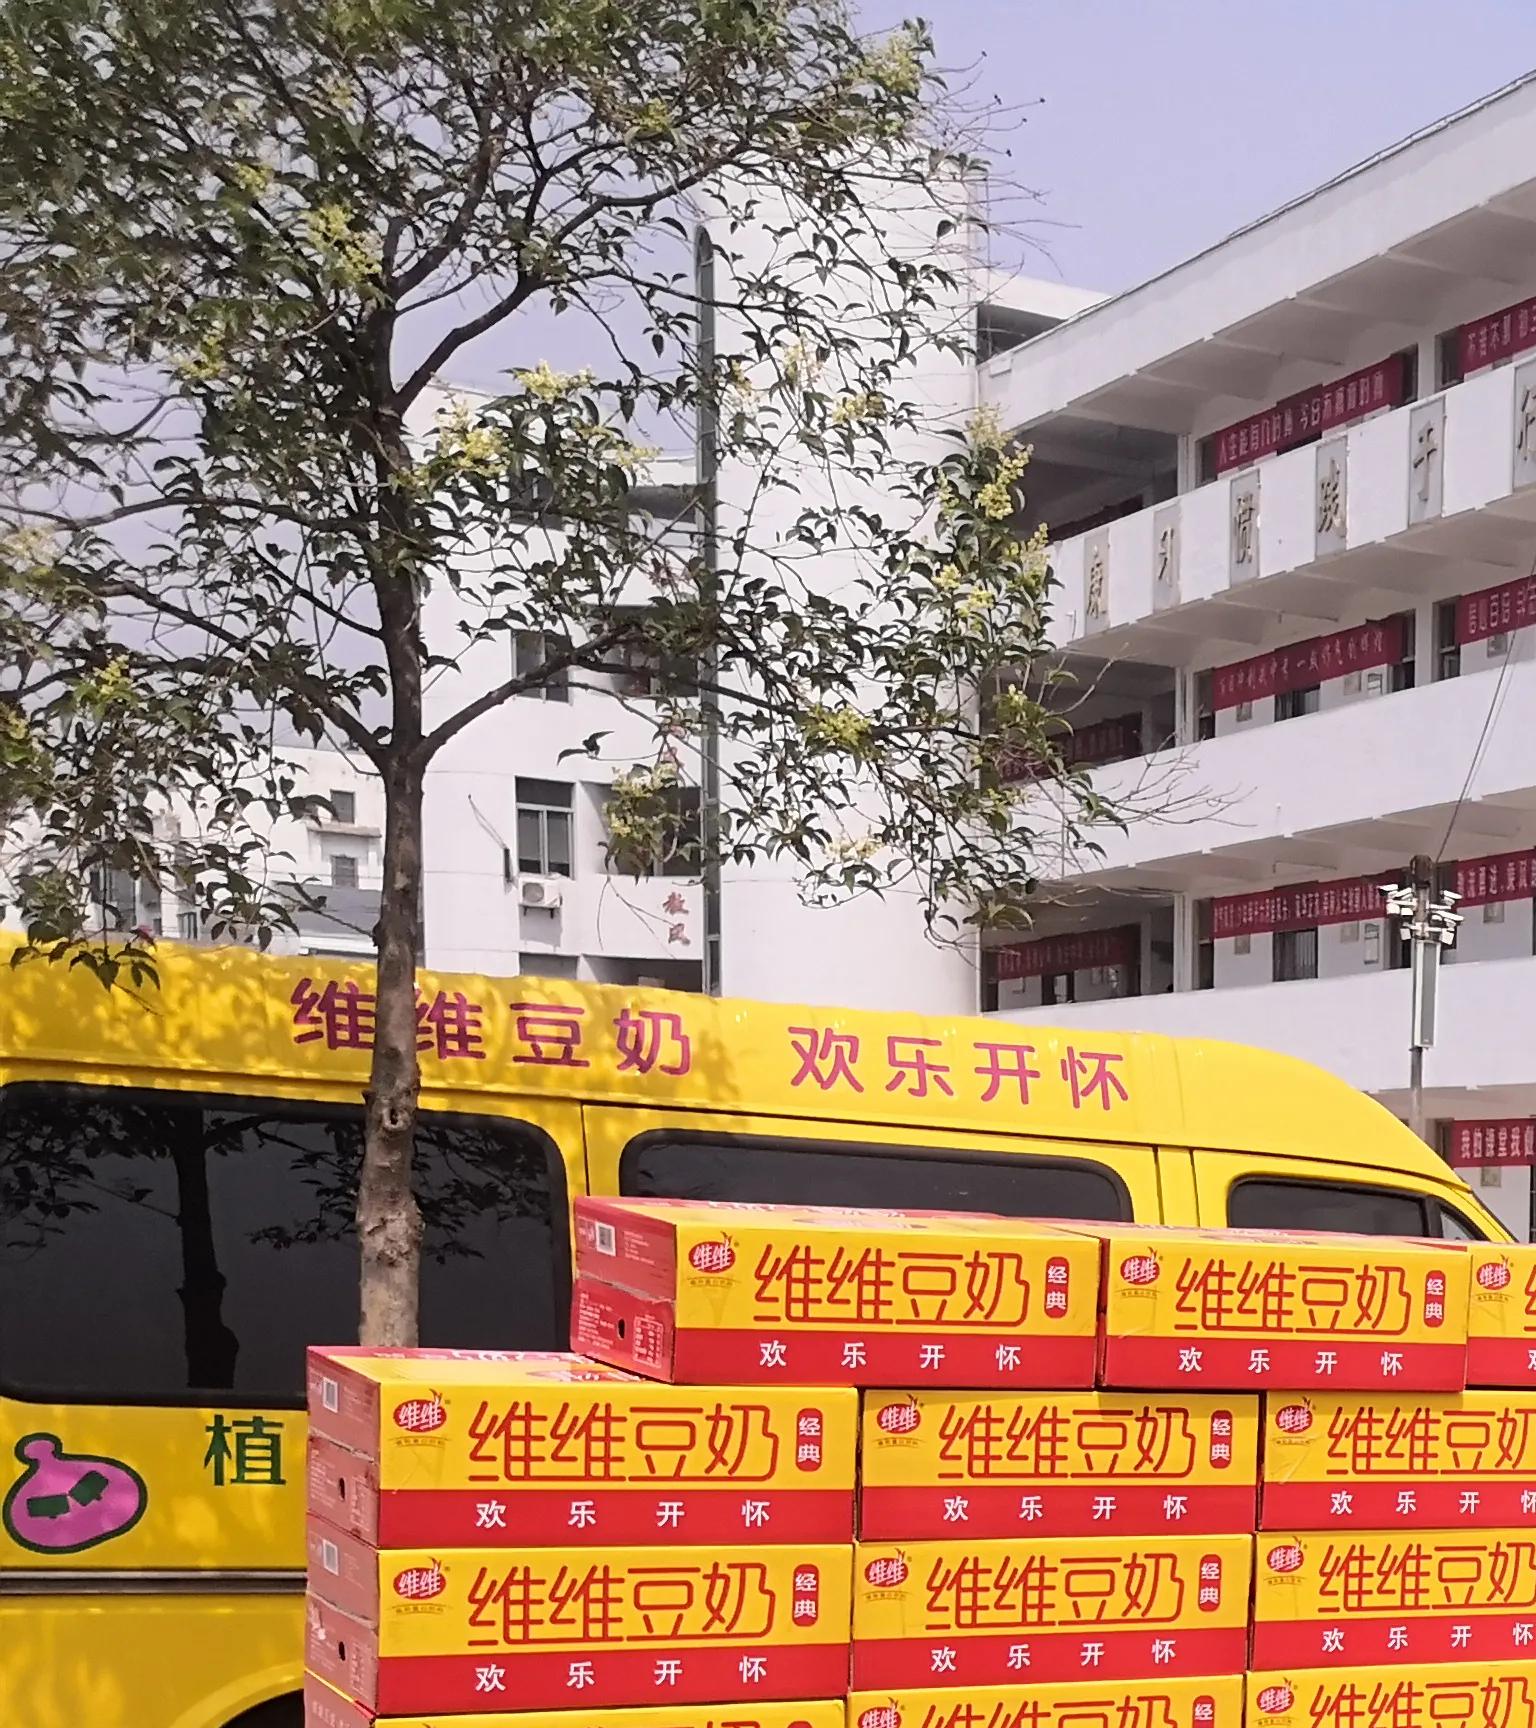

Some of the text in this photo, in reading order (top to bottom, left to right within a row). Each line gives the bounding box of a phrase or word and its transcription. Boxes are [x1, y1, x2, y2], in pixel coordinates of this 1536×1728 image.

[788, 1026, 1129, 1110] 欢乐开怀
[751, 1242, 1032, 1328] 维维豆奶
[1048, 1264, 1070, 1310] 经典
[1174, 1256, 1412, 1335] 维维豆奶
[1425, 1276, 1444, 1319] 经典
[756, 1340, 1024, 1369] 欢乐开怀
[1178, 1347, 1404, 1374] 欢乐开怀
[204, 1414, 286, 1486] 植
[466, 1400, 781, 1484] 维维豆奶
[800, 1415, 824, 1462] 经典
[939, 1405, 1196, 1480] 维维豆奶
[1210, 1418, 1231, 1461] 经典
[472, 1498, 773, 1529] 欢乐开怀
[944, 1493, 1188, 1521] 欢乐开怀
[464, 1560, 778, 1648] 维维豆奶
[797, 1572, 821, 1618] 经典
[927, 1550, 1183, 1631] 维维豆奶
[1198, 1562, 1218, 1605] 经典
[471, 1653, 770, 1691] 欢乐开怀
